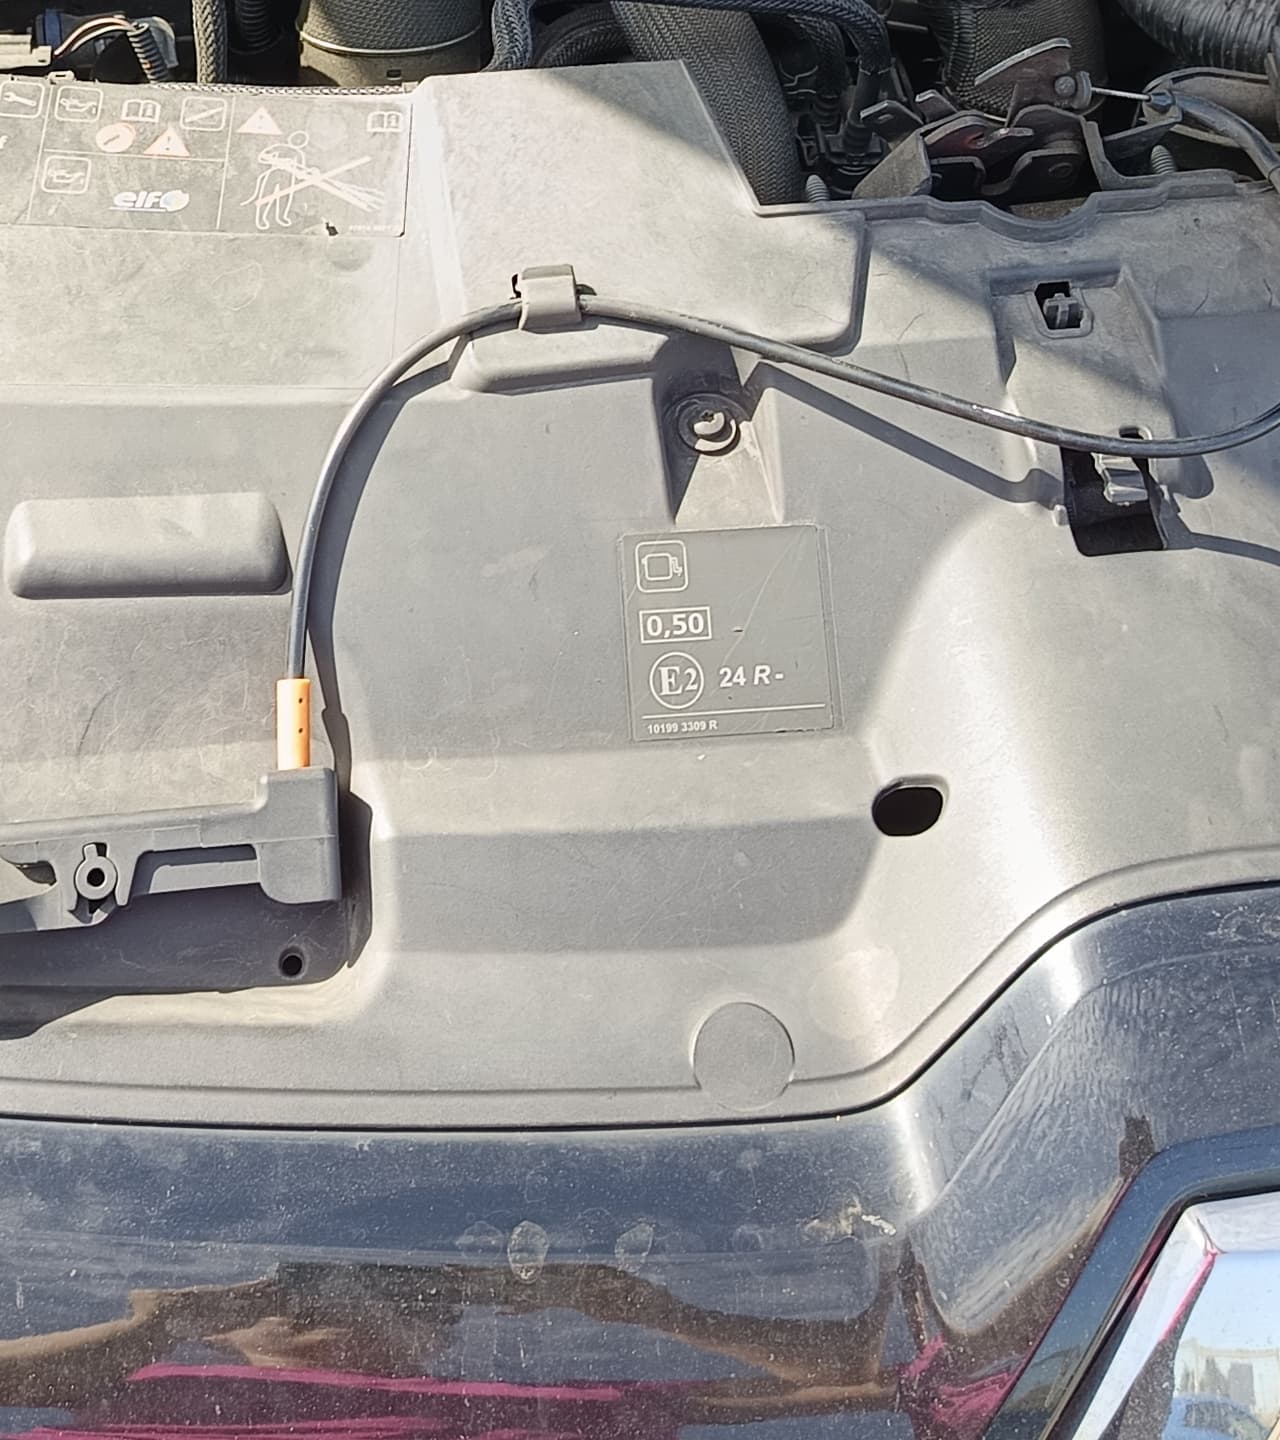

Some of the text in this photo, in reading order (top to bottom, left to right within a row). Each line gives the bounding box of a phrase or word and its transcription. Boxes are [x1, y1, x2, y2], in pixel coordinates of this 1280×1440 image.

[646, 613, 704, 639] 0,50
[658, 666, 699, 696] E2
[719, 667, 746, 688] 24
[681, 721, 706, 733] 3309
[709, 720, 718, 730] R
